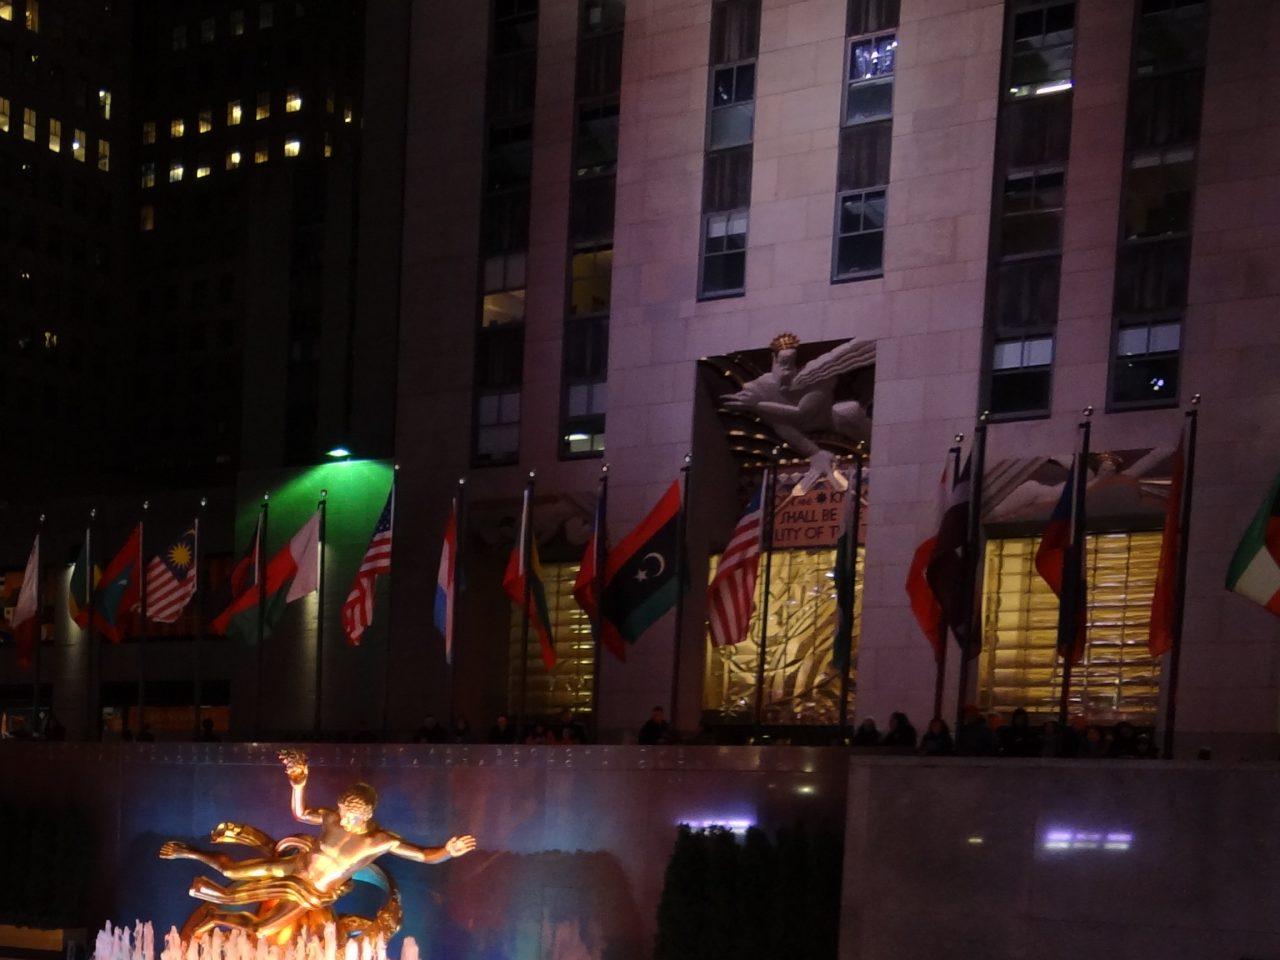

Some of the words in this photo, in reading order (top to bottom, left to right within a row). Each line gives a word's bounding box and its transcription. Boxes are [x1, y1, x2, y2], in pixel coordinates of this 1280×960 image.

[780, 509, 817, 525] SHALL
[822, 507, 837, 521] BE
[805, 526, 824, 540] OF
